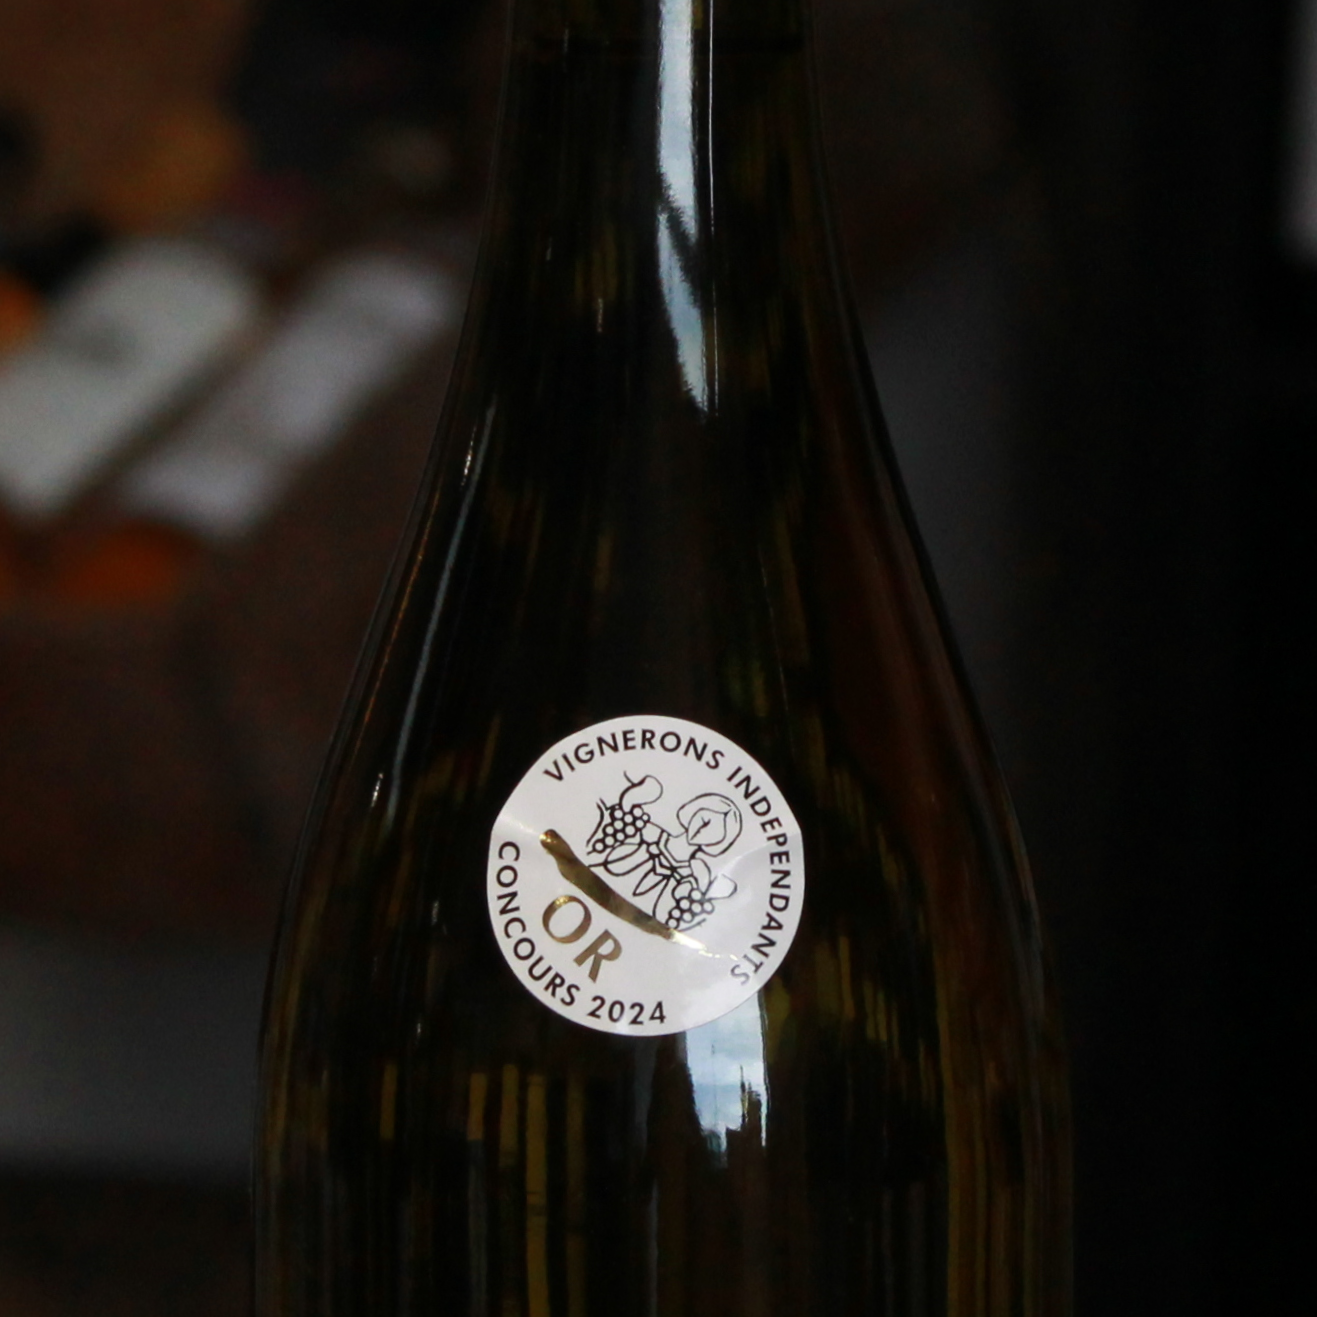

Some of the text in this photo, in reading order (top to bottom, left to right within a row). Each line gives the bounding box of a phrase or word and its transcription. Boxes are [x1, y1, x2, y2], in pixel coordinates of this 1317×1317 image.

[496, 841, 667, 1025] CONCOURS 2024
[542, 895, 622, 983] OR
[543, 729, 792, 985] VIGNERONS INDEPENDANTS
